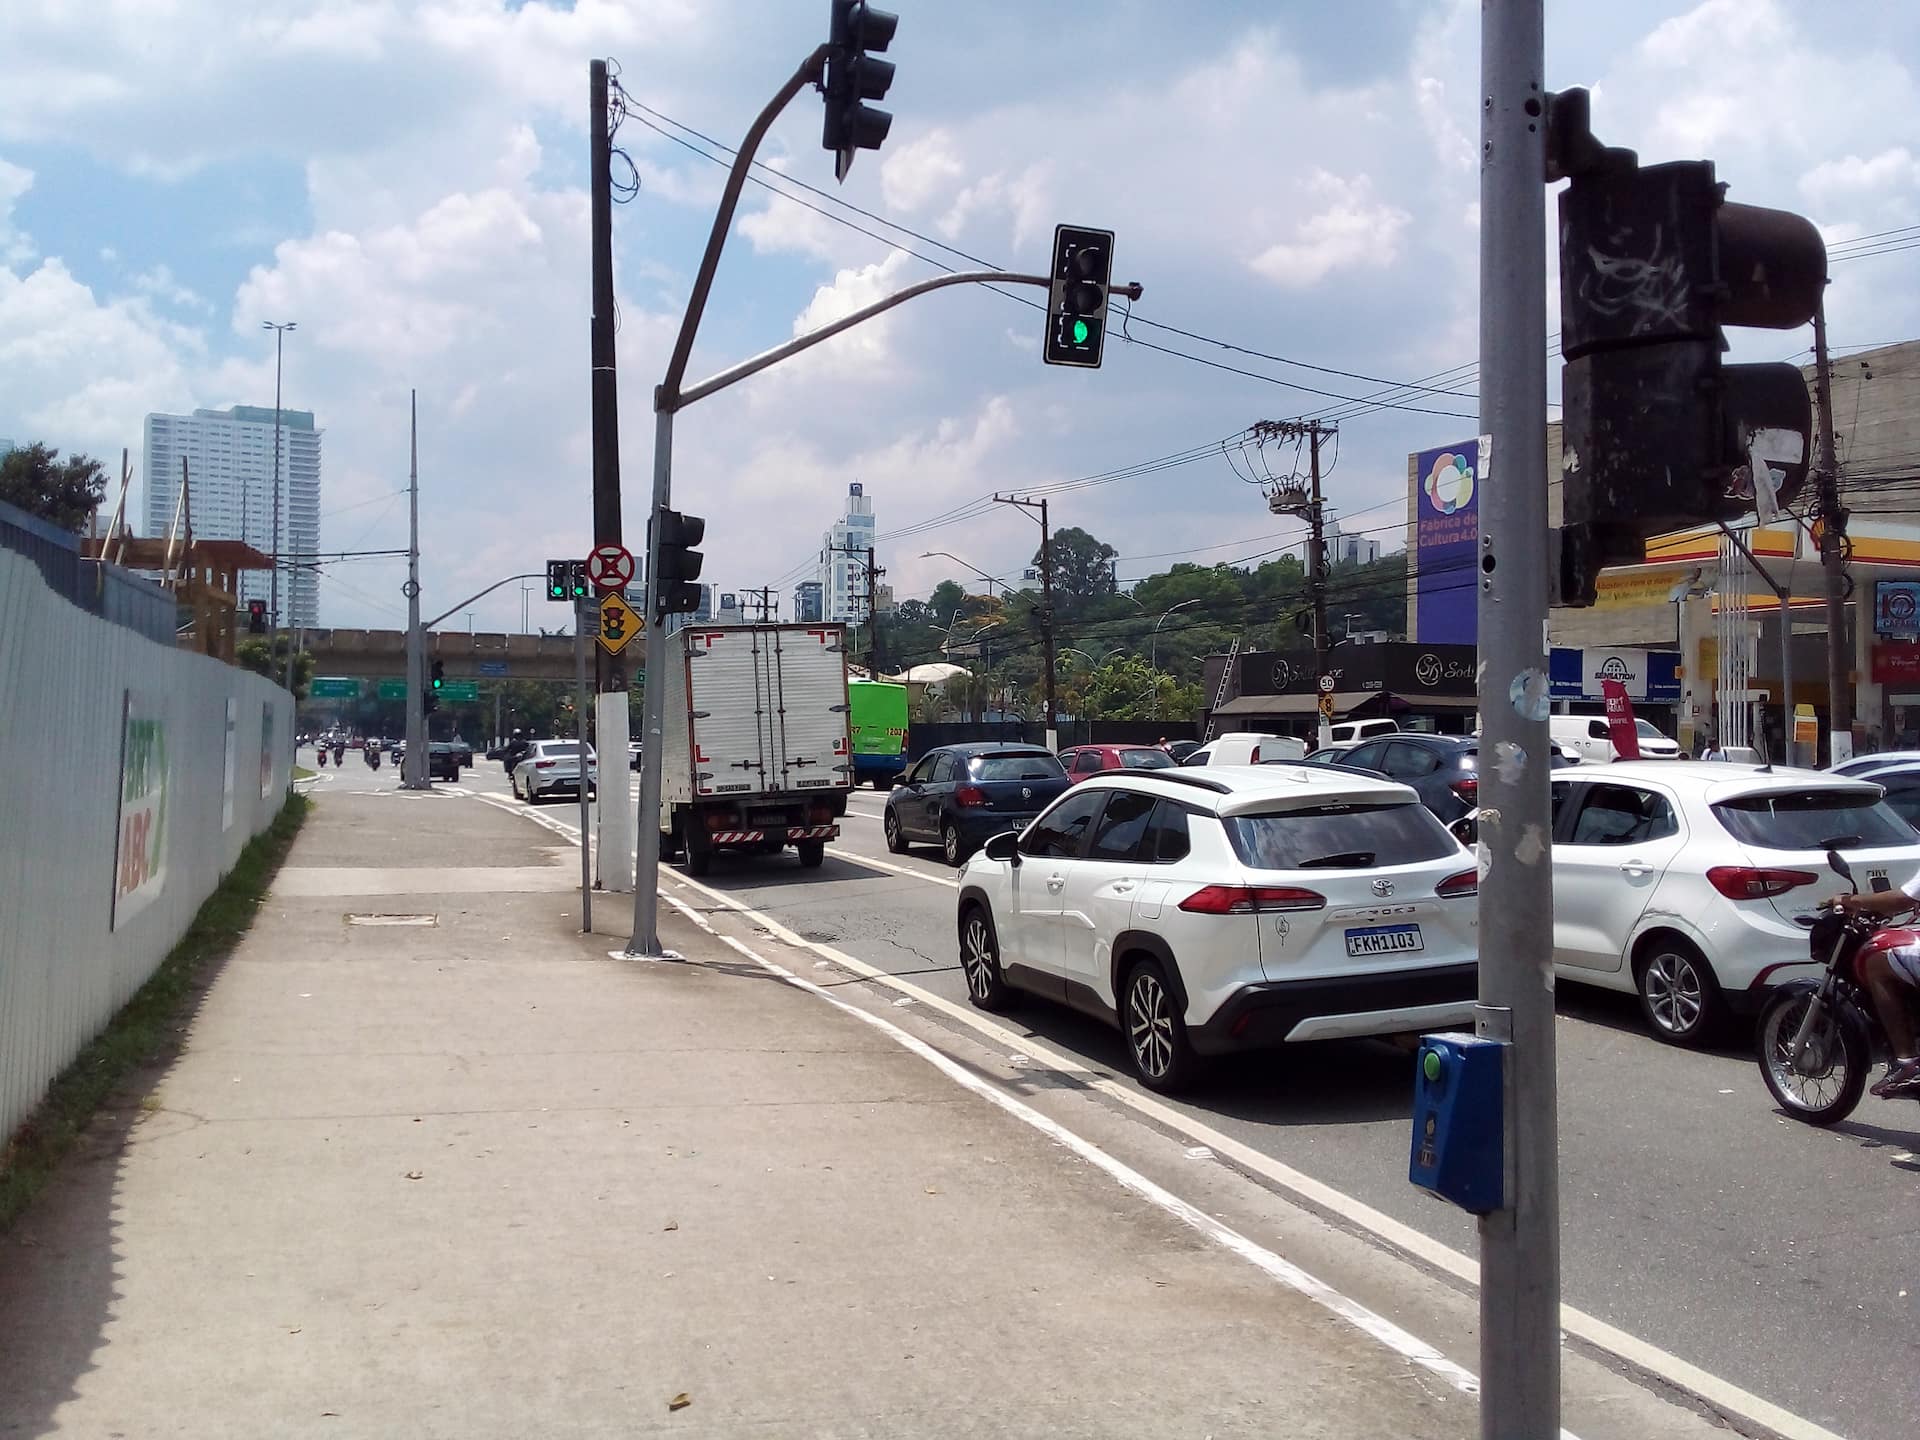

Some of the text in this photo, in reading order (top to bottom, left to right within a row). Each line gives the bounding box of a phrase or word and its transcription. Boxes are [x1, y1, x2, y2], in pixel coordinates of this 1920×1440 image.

[1463, 512, 1477, 526] de
[1420, 528, 1477, 547] Cultura 4.0
[1595, 671, 1636, 681] SENSATION
[1322, 679, 1333, 688] 50
